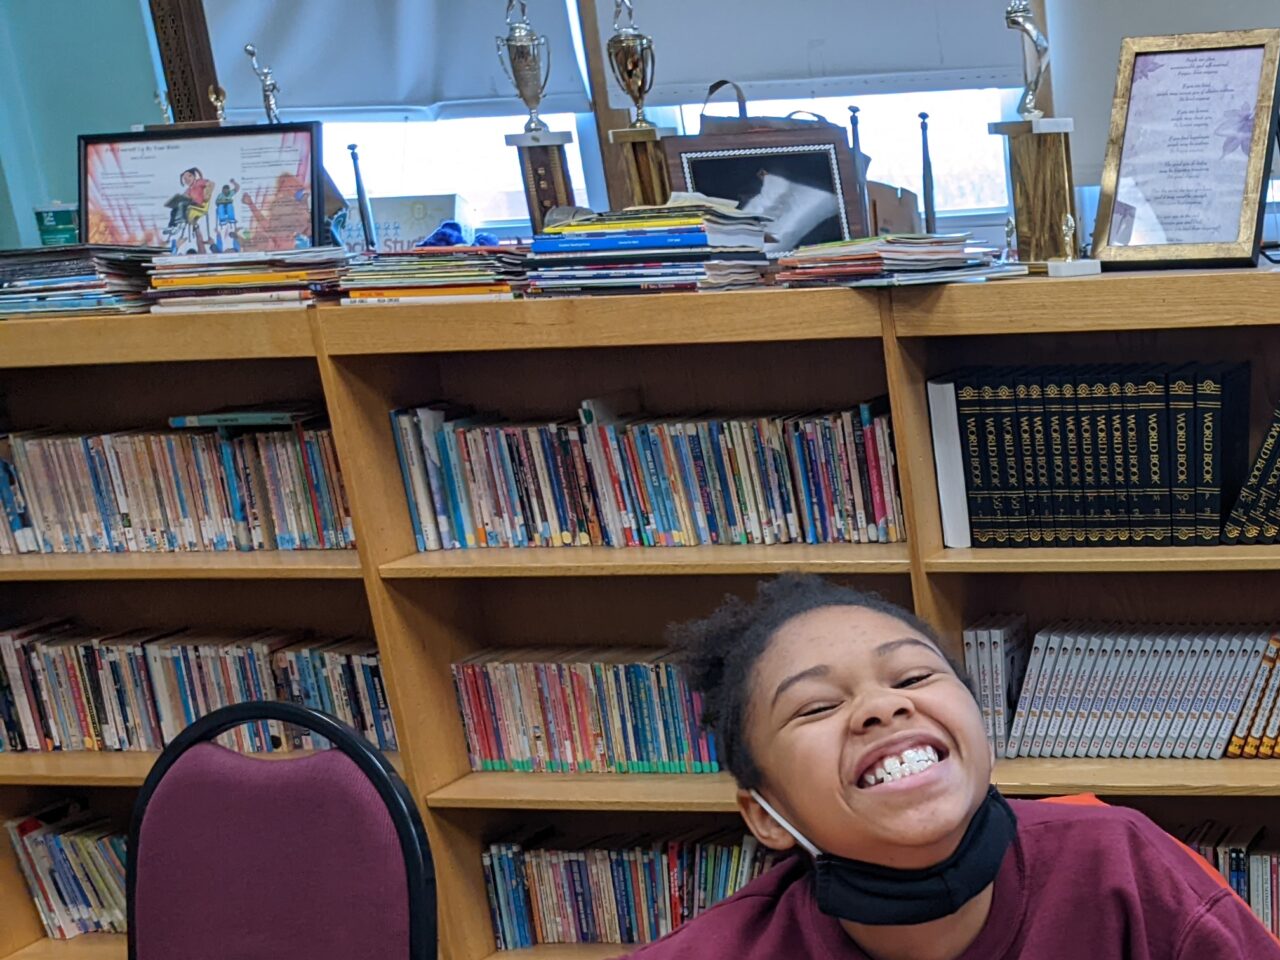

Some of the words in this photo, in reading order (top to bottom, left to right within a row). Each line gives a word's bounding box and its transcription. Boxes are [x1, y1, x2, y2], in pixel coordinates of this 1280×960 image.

[967, 417, 978, 455] WORLD
[985, 417, 997, 456] WORLD
[1003, 416, 1015, 456] WORLD
[1020, 416, 1031, 454] WORLD
[1033, 416, 1044, 454] WORLD
[1051, 416, 1061, 454] WORLD
[1067, 416, 1077, 454] WORLD
[1081, 416, 1092, 454] WORLD
[1097, 415, 1108, 454] WORLD
[1112, 415, 1123, 453] WORLD
[1127, 415, 1137, 453] WORLD
[1148, 413, 1158, 452] WORLD
[1176, 413, 1186, 452] WORLD
[1204, 412, 1213, 451] WORLD
[971, 457, 983, 487] BOOK
[990, 458, 1000, 487] BOOK
[1007, 457, 1017, 487] BOOK
[1024, 457, 1034, 486] BOOK
[1037, 456, 1048, 486] BOOK
[1054, 456, 1064, 485] BOOK
[1070, 456, 1080, 486] BOOK
[1085, 456, 1094, 486] BOOK
[1100, 456, 1109, 485] BOOK
[1115, 455, 1124, 484] BOOK
[1129, 455, 1139, 484] BOOK
[1151, 454, 1160, 484] BOOK
[1178, 454, 1187, 483] BOOK
[1203, 453, 1212, 483] BOOK
[1248, 458, 1264, 485] BOOK
